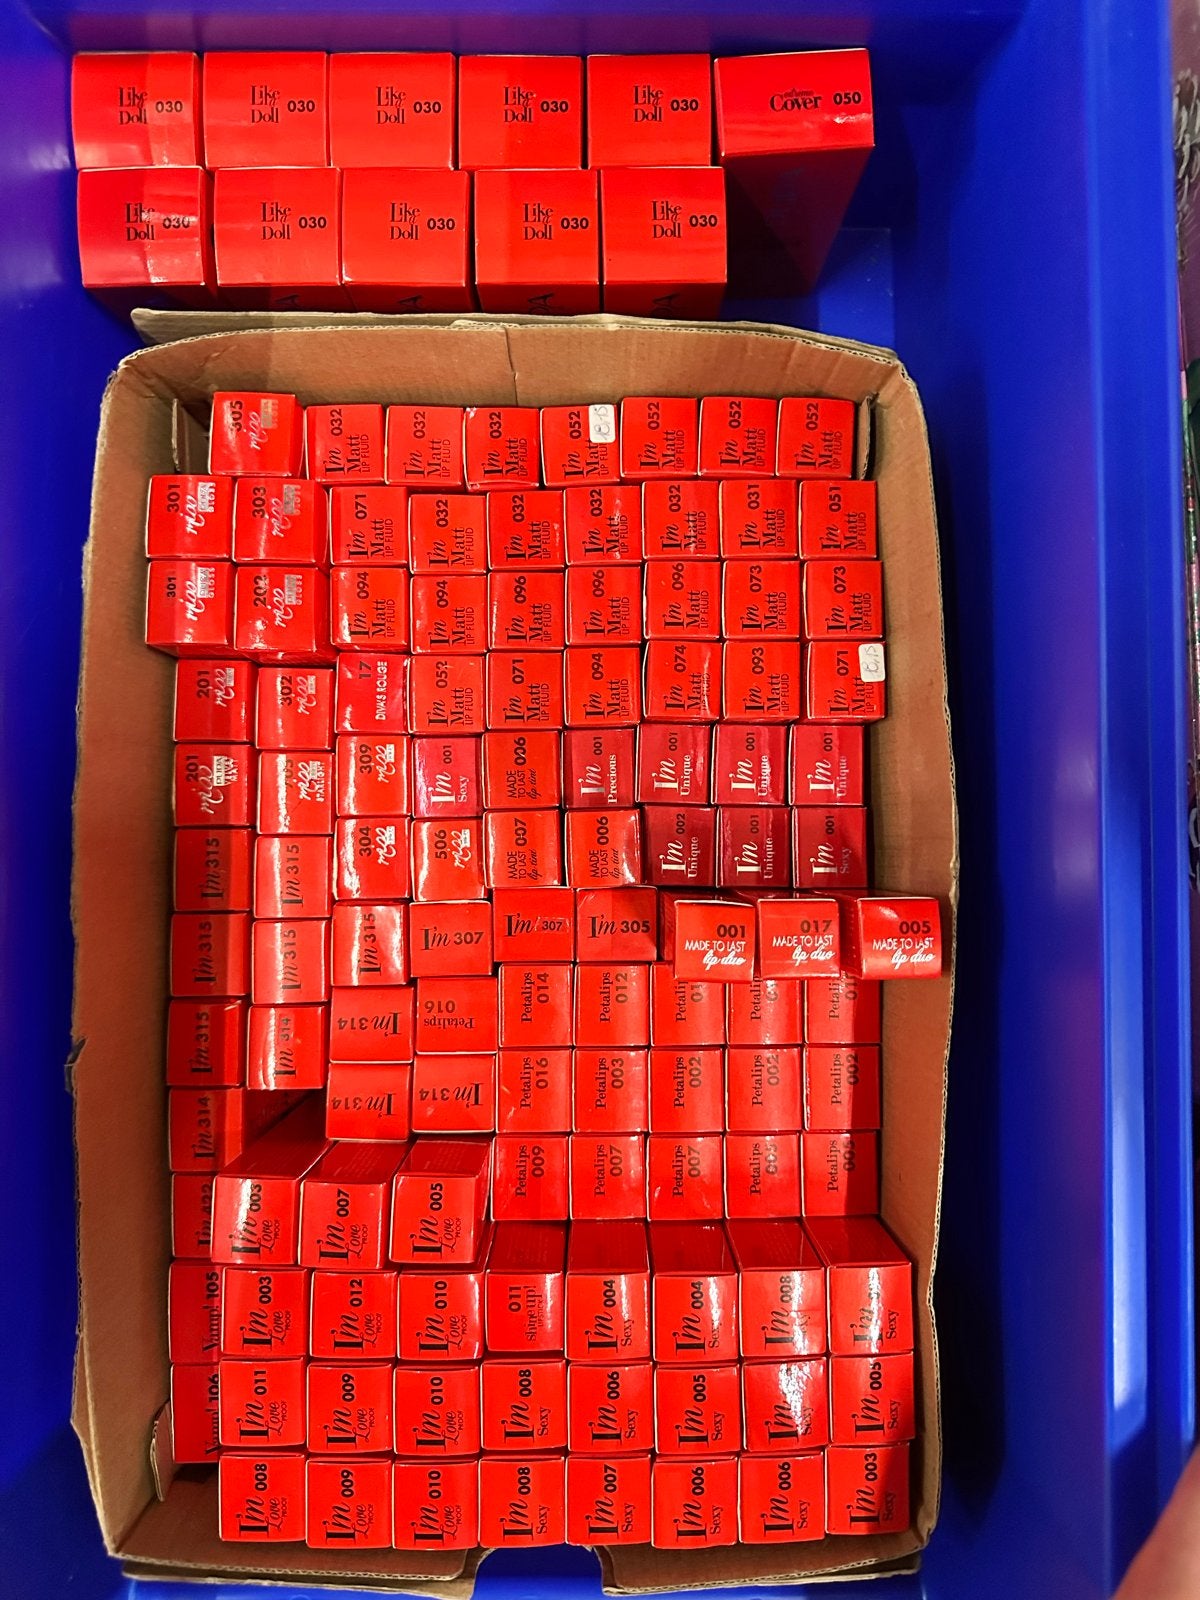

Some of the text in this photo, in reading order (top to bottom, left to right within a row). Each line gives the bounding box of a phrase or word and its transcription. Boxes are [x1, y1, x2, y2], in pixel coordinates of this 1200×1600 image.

[118, 87, 148, 107] Like
[251, 85, 280, 105] Like
[376, 87, 406, 106] Like
[504, 86, 534, 106] Like
[634, 86, 663, 105] Like
[770, 94, 822, 113] Cover
[833, 92, 861, 105] 050
[119, 100, 183, 125] Doll 030
[251, 99, 315, 123] Doll 030
[376, 100, 442, 125] Doll 030
[504, 100, 569, 123] Doll 030
[634, 98, 699, 122] Doll 030
[261, 203, 291, 221] Like
[390, 203, 420, 222] Like
[523, 203, 553, 223] Like
[652, 201, 682, 221] Like
[262, 216, 327, 240] Doll 030
[390, 217, 455, 240] Doll 030
[524, 217, 589, 241] Doll 030
[652, 215, 717, 239] Doll 030
[325, 408, 347, 477] I'm 032
[481, 411, 503, 476] I'm 032
[719, 401, 741, 466] I'm 052
[742, 428, 757, 465] Matt
[348, 434, 368, 474] Matt
[505, 438, 519, 475] Matt
[167, 485, 181, 513] 301
[252, 487, 266, 518] 303
[350, 493, 368, 559] I'm 071
[739, 485, 760, 548] I'm 031
[763, 509, 776, 547] Matt
[368, 518, 384, 557] Matt
[357, 571, 369, 599] 094
[740, 565, 762, 632] I'm 073
[506, 576, 527, 643] I'm 096
[529, 604, 543, 641] Matt
[764, 592, 778, 630] Matt
[359, 661, 371, 679] 17
[377, 662, 387, 691] ROUGE
[837, 650, 849, 677] 071
[197, 670, 210, 697] 201
[743, 647, 765, 713] I'm 093
[767, 673, 780, 711] Matt
[359, 744, 372, 773] 309
[578, 737, 605, 798] I'm 001
[652, 732, 678, 792] I'm 001
[428, 746, 456, 806] I'm 001
[457, 776, 469, 803] Sexy
[506, 771, 517, 798] MADE
[608, 754, 617, 803] Precious
[680, 755, 692, 796] Unique
[518, 787, 525, 798] TO
[359, 826, 371, 857] 304
[435, 830, 447, 859] 506
[597, 816, 608, 845] 006
[659, 814, 687, 876] I'm 002
[688, 837, 699, 878] Unique
[364, 913, 376, 943] 315
[421, 926, 484, 950] I'm 307
[505, 913, 562, 936] I'm 307
[588, 915, 650, 938] I'm 305
[717, 924, 746, 938] 001
[800, 920, 832, 932] 017
[899, 921, 930, 934] 005
[685, 941, 745, 951] MADE TO LAST
[521, 973, 533, 1022] Petalips
[537, 973, 549, 1003] 014
[600, 973, 611, 1022] Petalips
[615, 973, 628, 1003] 012
[425, 1000, 455, 1013] 016
[337, 1013, 400, 1036] I'm 314
[424, 1018, 475, 1029] Petalips
[520, 1057, 531, 1109] Petalips
[536, 1058, 548, 1089] 016
[595, 1058, 609, 1109] Petalips
[612, 1058, 623, 1089] 003
[532, 1146, 545, 1178] 009
[610, 1146, 623, 1177] 007
[317, 1189, 349, 1263] I'm 007
[410, 1183, 442, 1258] I'm 005
[441, 1218, 455, 1252] Love
[347, 1224, 361, 1257] Love
[206, 1272, 219, 1300] 105
[435, 1280, 447, 1309] 010
[509, 1286, 521, 1311] 011
[239, 1276, 273, 1349] I'm 003
[273, 1311, 286, 1343] Love
[331, 1279, 364, 1352] I'm 012
[585, 1280, 618, 1353] I'm 004
[362, 1314, 375, 1346] Love
[621, 1319, 635, 1346] Sexy
[255, 1370, 266, 1395] 011
[342, 1374, 354, 1402] 009
[501, 1369, 535, 1443] I'm 008
[588, 1372, 623, 1445] I'm 006
[852, 1362, 884, 1436] I'm 005
[538, 1407, 551, 1435] Sexy
[625, 1410, 638, 1438] Sexy
[889, 1401, 900, 1429] Sexy
[865, 1453, 877, 1482] 003
[236, 1463, 270, 1536] I'm 008
[585, 1465, 619, 1539] I'm 007
[761, 1462, 794, 1538] I'm 006
[623, 1503, 636, 1532] Sexy
[797, 1500, 810, 1529] Sexy
